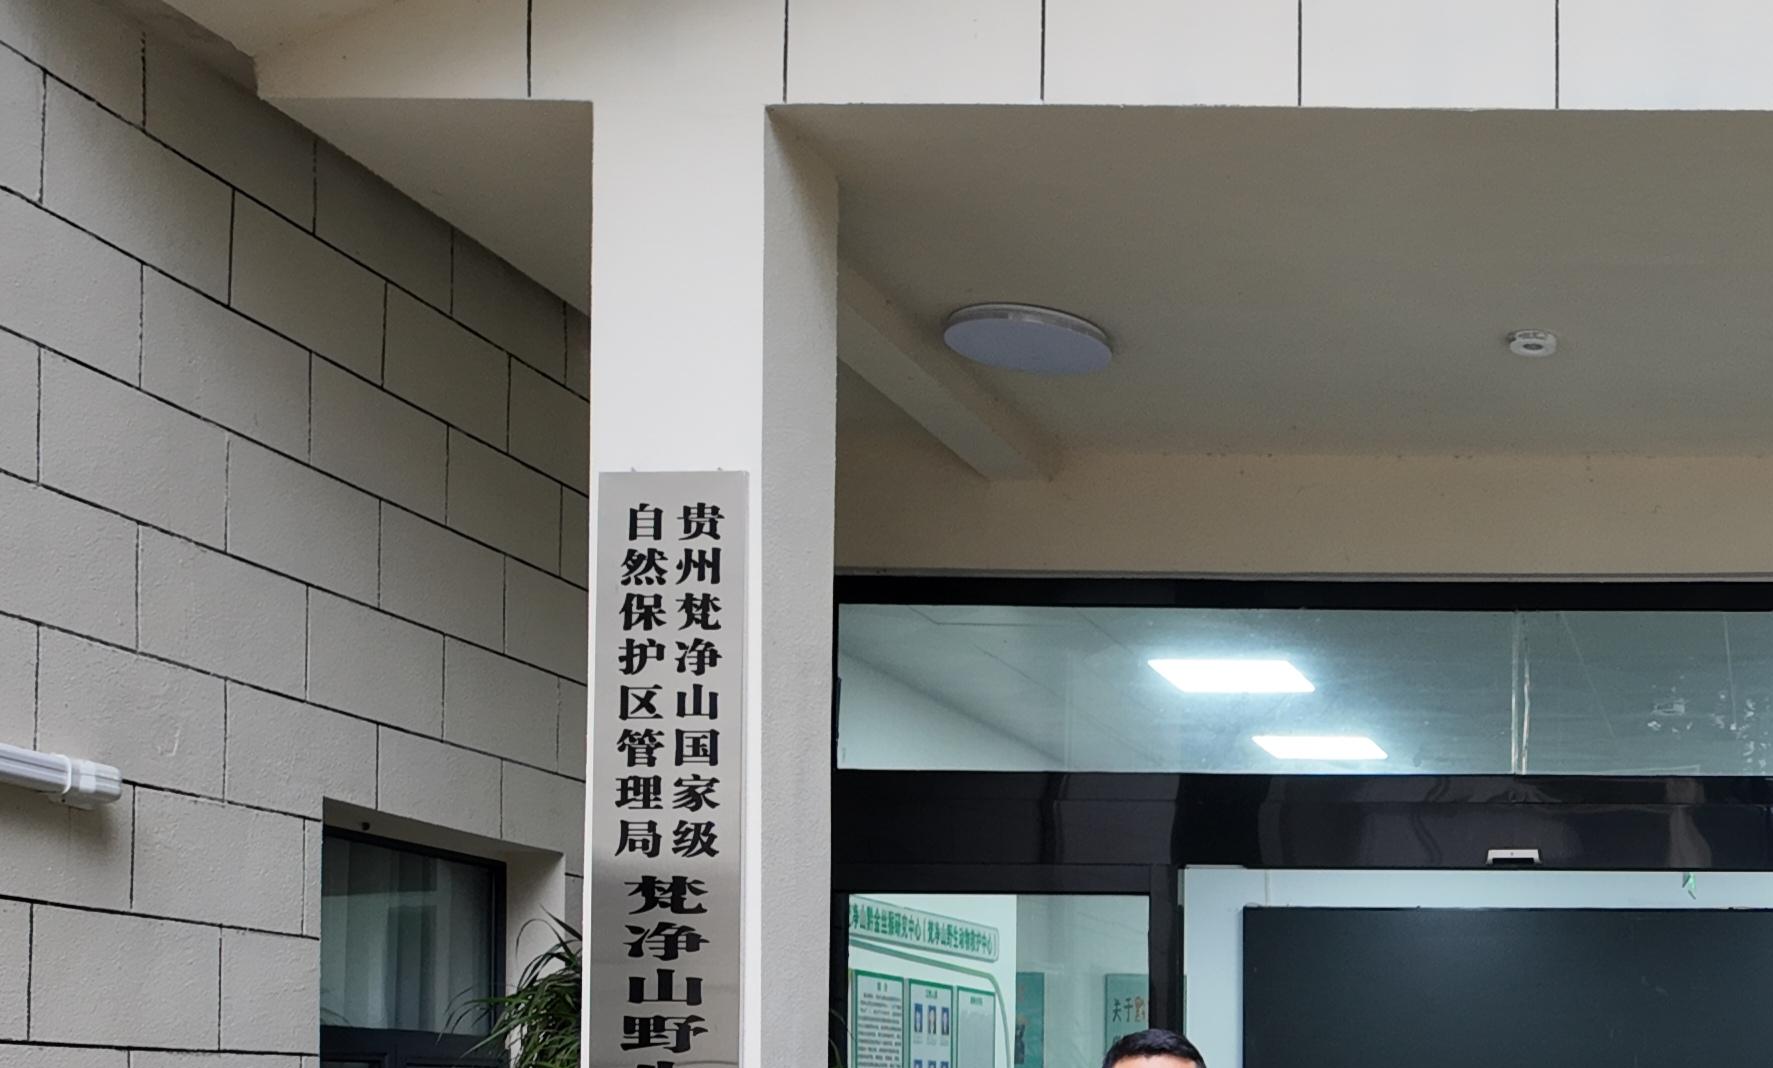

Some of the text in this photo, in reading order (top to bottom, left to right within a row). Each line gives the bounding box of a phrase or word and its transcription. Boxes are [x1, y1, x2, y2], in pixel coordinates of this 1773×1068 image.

[614, 503, 666, 858] 自然保护区管理局
[672, 502, 725, 858] 贵州梵净山国家级
